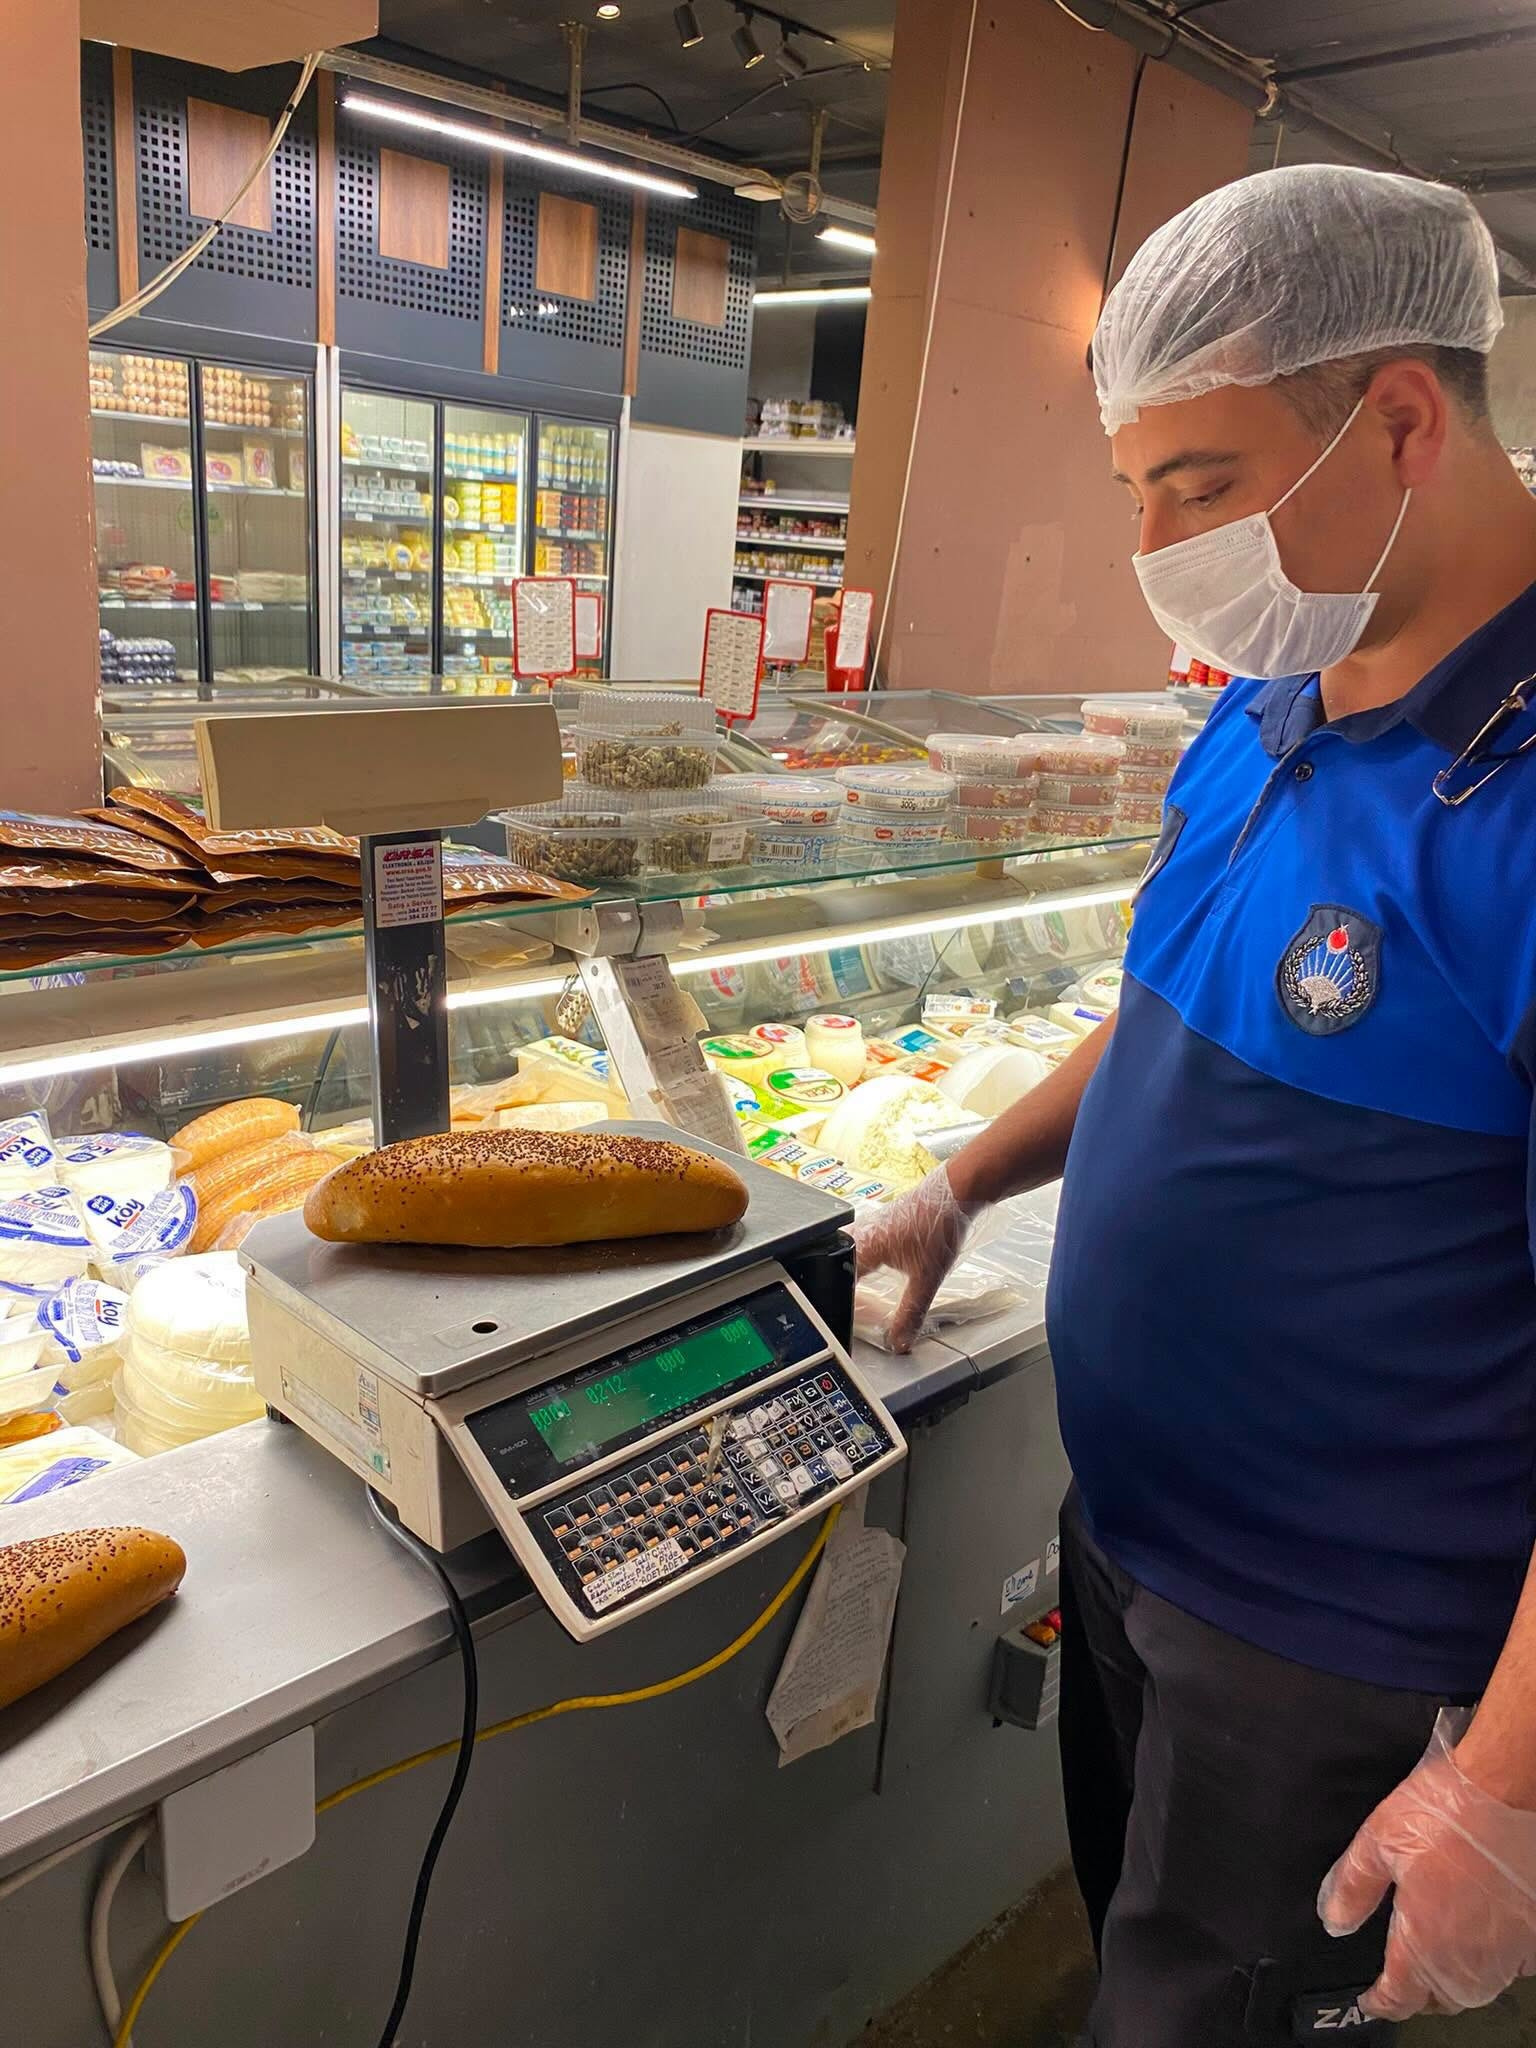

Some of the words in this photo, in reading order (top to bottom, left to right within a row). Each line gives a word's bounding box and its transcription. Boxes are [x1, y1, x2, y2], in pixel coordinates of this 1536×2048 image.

[106, 1198, 145, 1228] köy
[585, 1374, 627, 1405] 0,212
[785, 1394, 803, 1406] FIX
